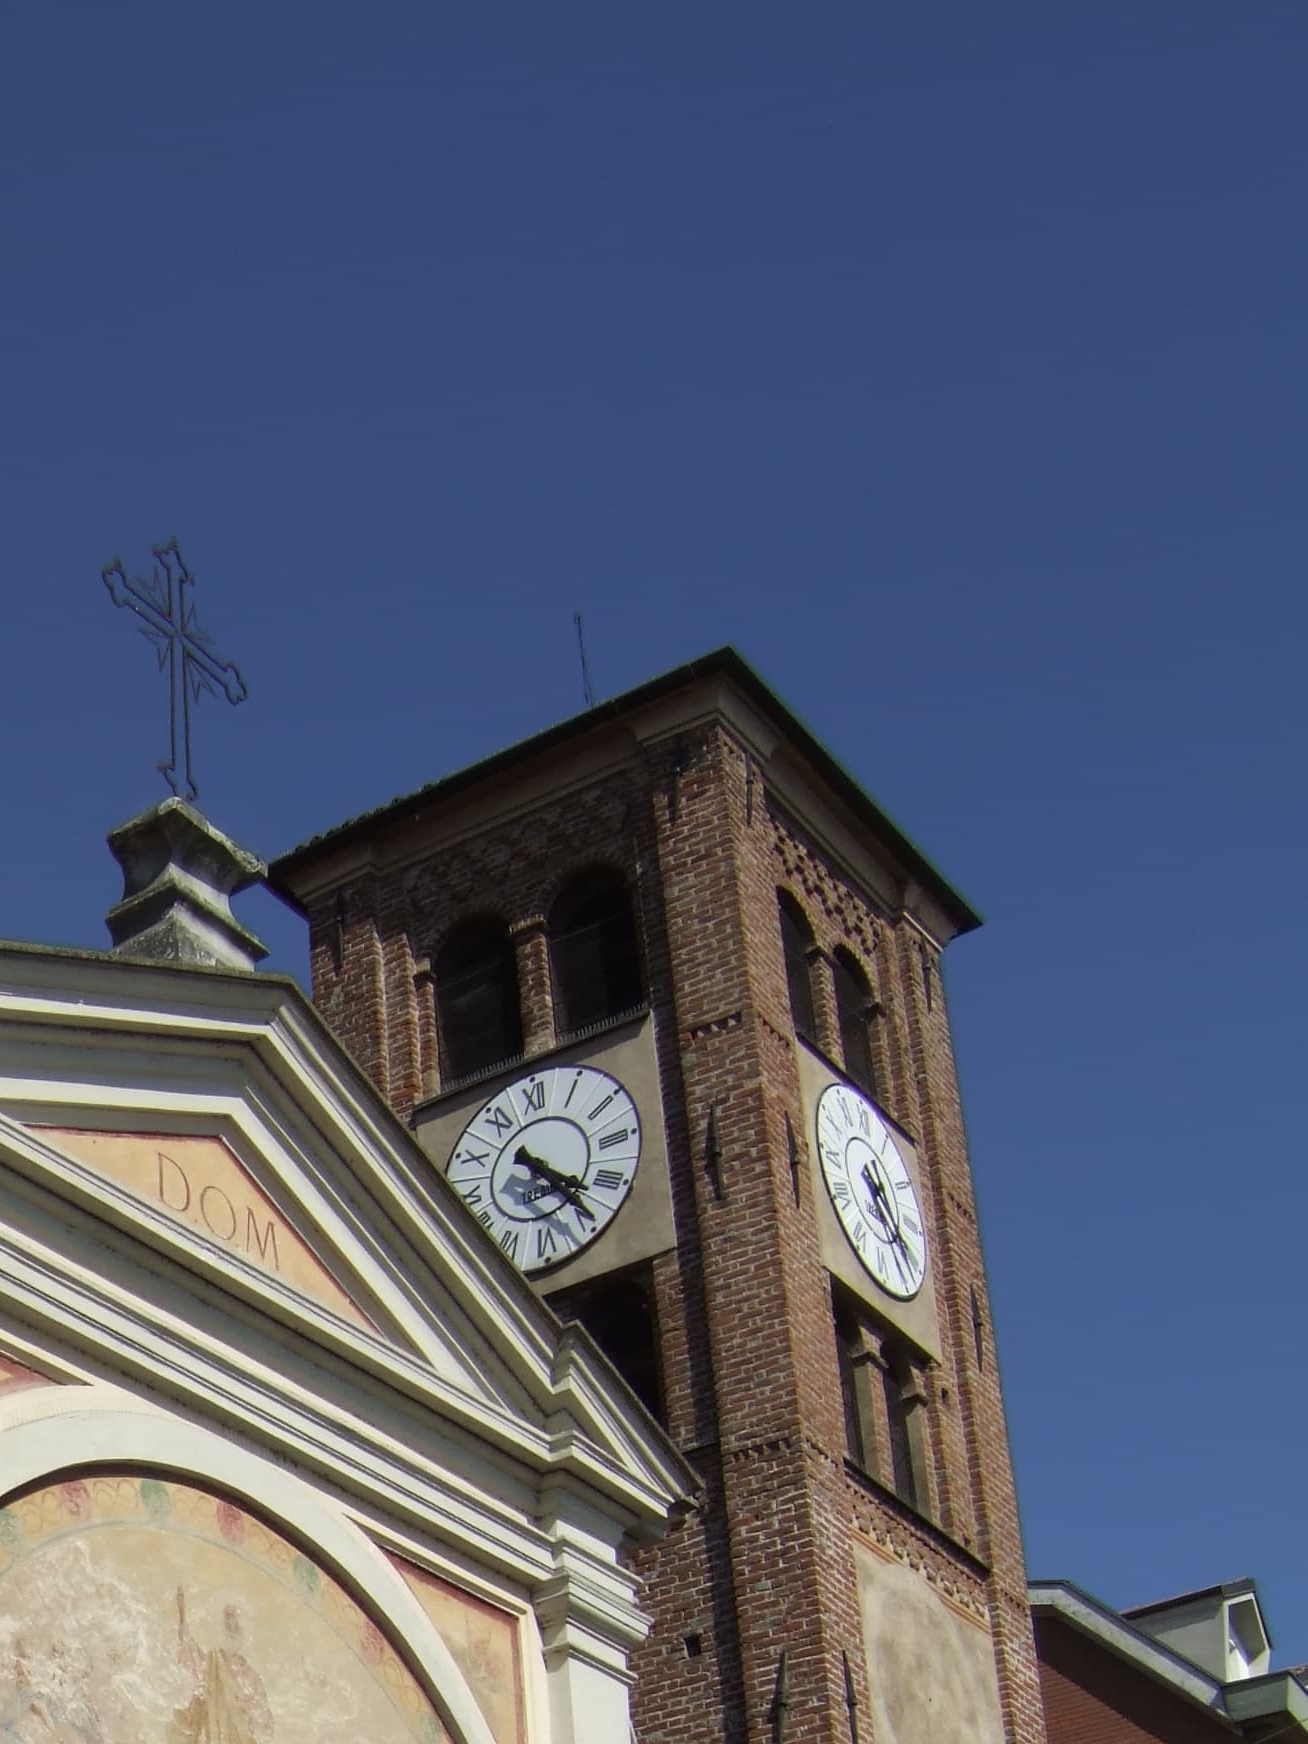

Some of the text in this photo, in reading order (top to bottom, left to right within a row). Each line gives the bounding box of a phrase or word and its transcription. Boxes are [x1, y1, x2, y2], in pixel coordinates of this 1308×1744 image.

[522, 1080, 546, 1116] XII
[485, 1106, 514, 1139] XI
[599, 1128, 630, 1151] III
[461, 1149, 491, 1168] X
[537, 1226, 557, 1258] VI
